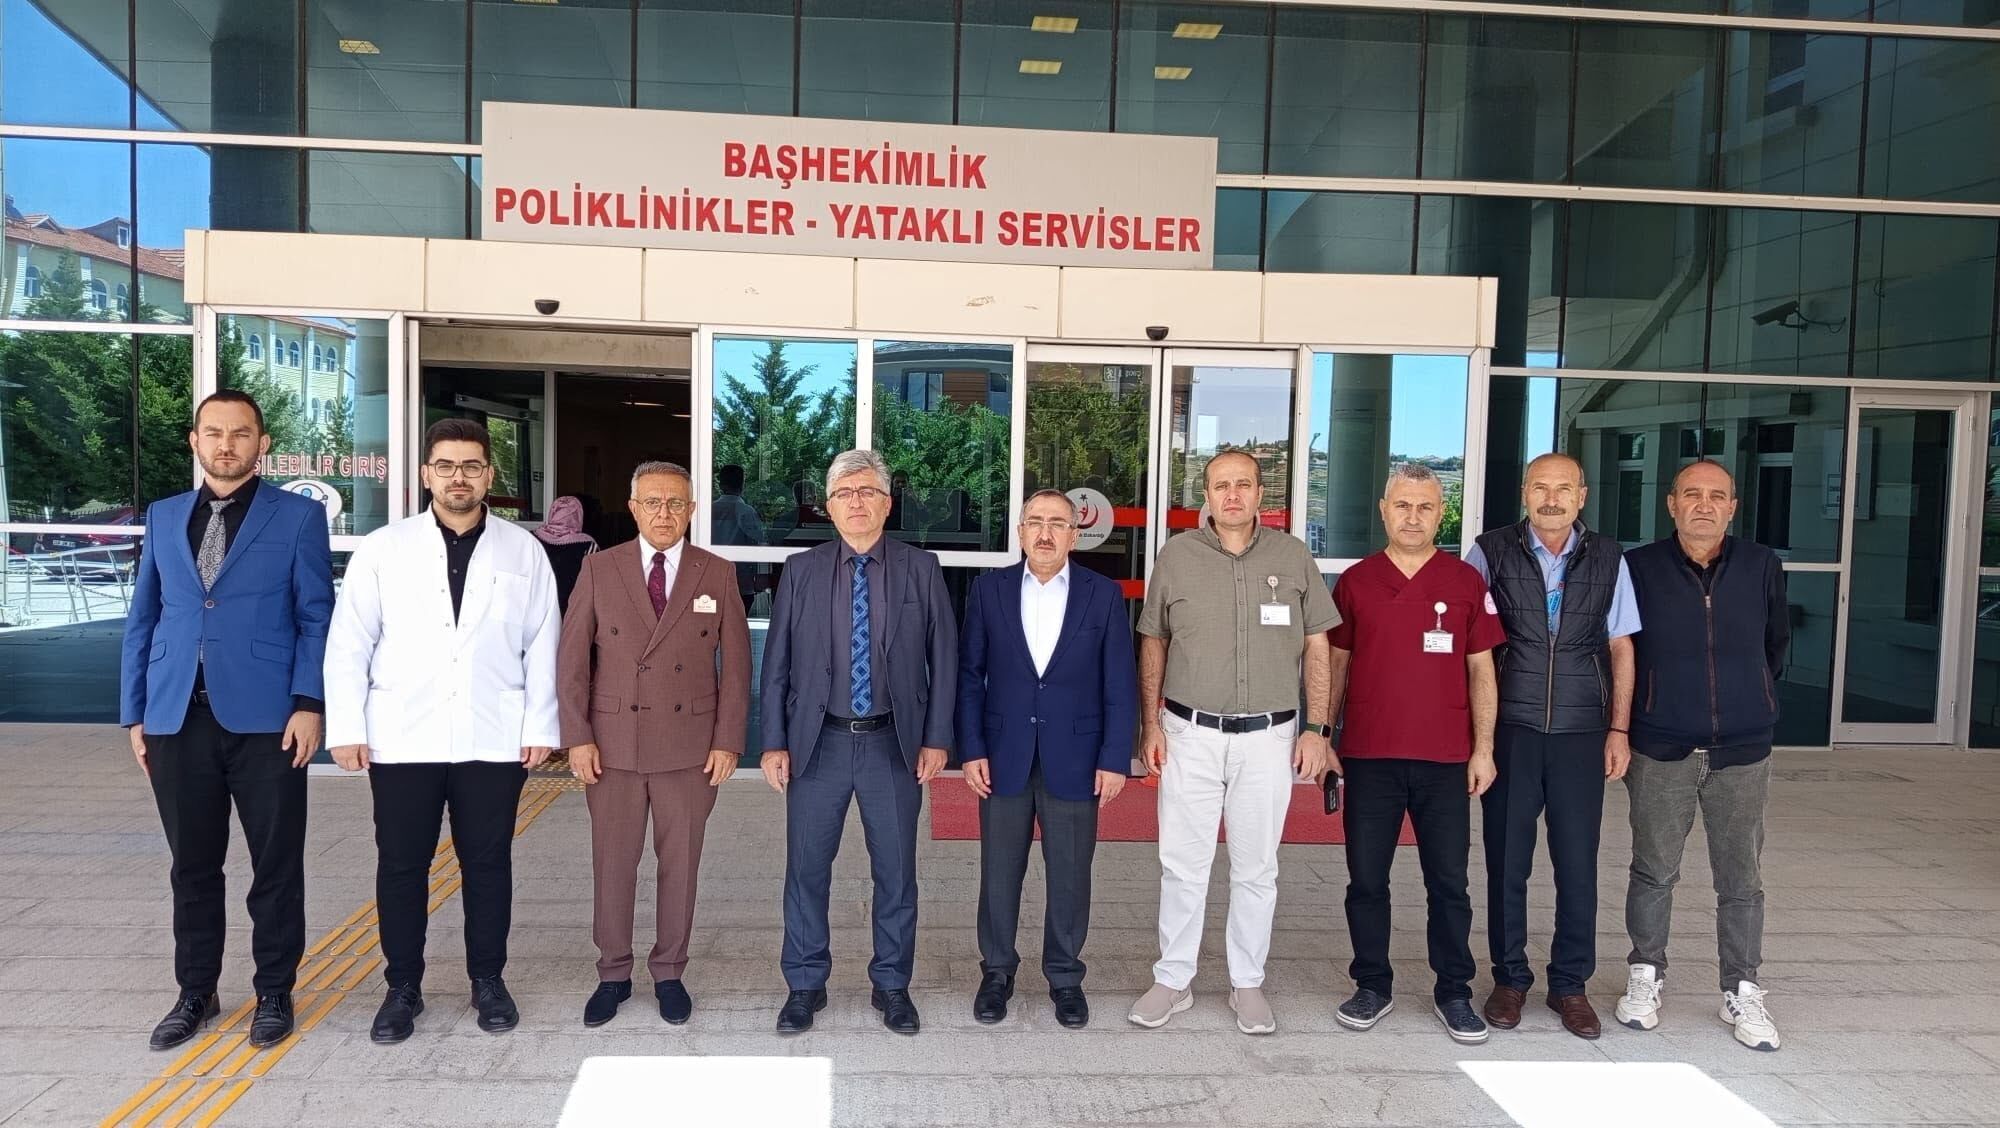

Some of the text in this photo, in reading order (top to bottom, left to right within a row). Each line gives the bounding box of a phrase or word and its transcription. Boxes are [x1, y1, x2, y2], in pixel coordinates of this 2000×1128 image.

[724, 142, 987, 190] BAŞHEKİMLİK
[495, 182, 795, 236] POLİKLİNİKLER
[829, 203, 984, 244] YATAKLI
[998, 207, 1200, 252] SERVİSLER
[340, 452, 387, 483] GİRİŞ
